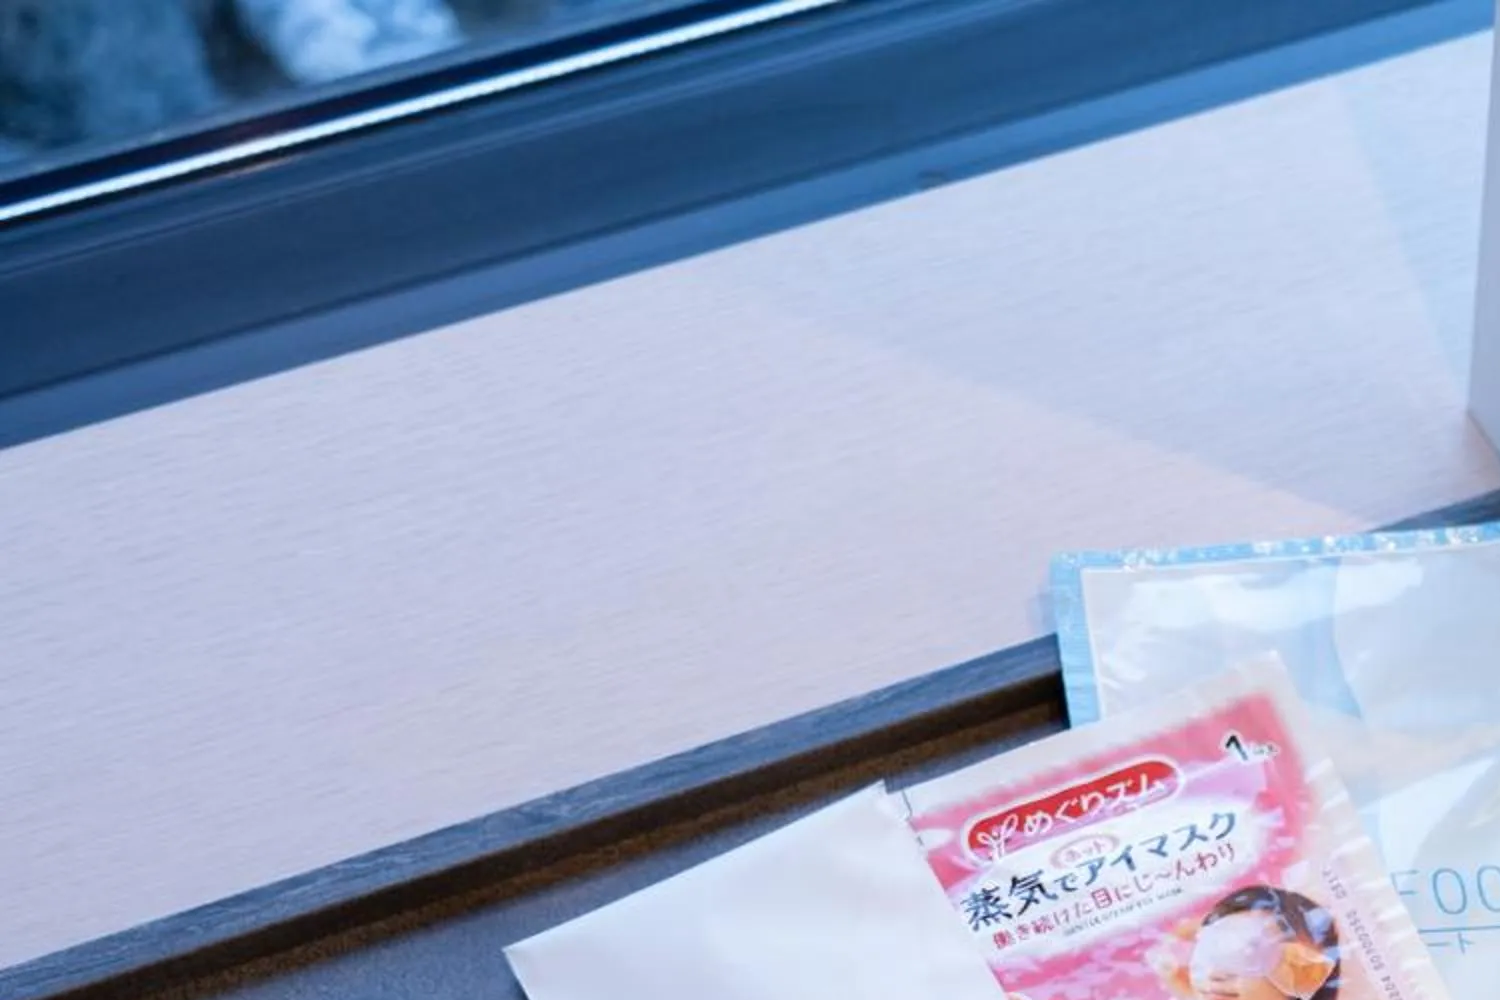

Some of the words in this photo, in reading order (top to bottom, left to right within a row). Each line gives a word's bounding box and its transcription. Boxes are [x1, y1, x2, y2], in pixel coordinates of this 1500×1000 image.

[1022, 772, 1166, 836] めぐりズム
[961, 811, 1237, 932] 蒸気でアイマスク
